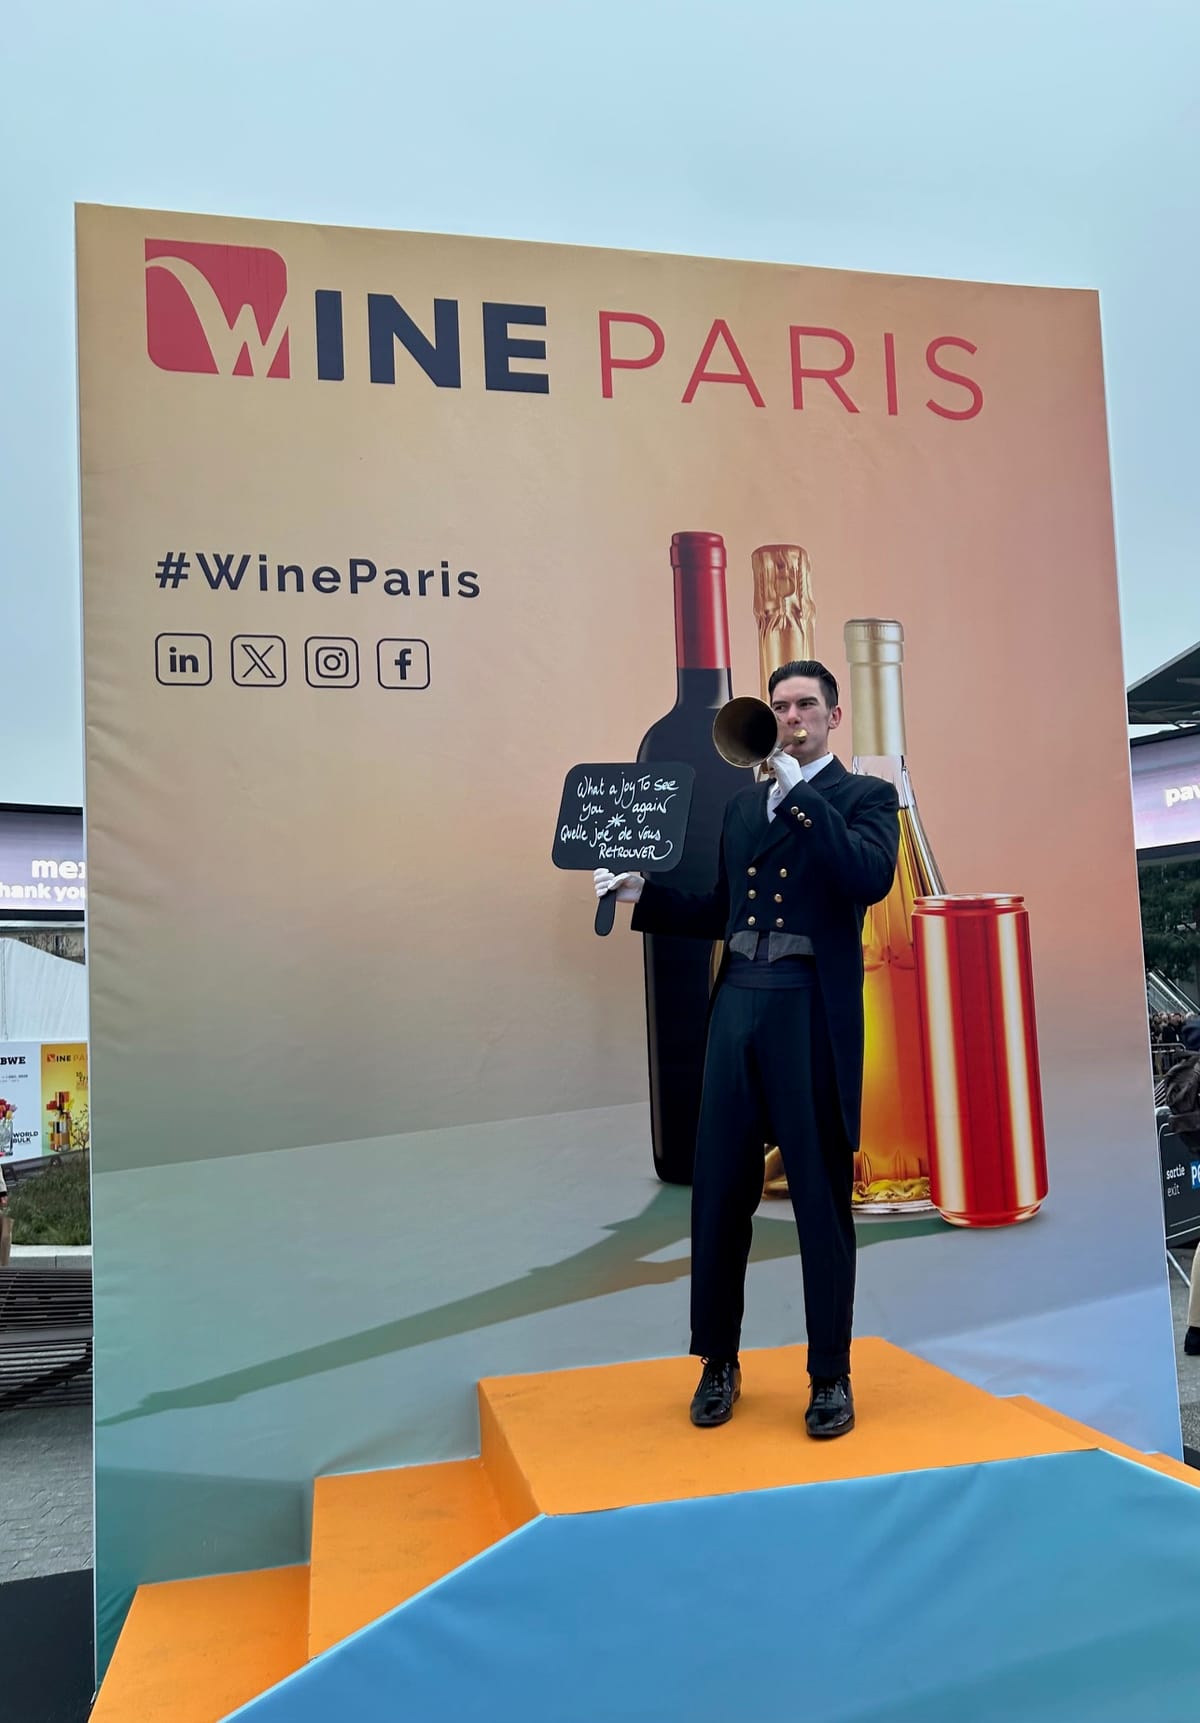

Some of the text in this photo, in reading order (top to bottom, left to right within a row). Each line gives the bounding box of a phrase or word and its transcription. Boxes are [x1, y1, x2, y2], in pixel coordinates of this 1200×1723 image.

[599, 310, 984, 421] PARIS
[155, 552, 481, 598] #WineParis
[169, 647, 199, 673] in
[394, 648, 412, 680] f
[577, 776, 605, 798] What
[609, 784, 618, 795] a
[615, 772, 636, 809] joy
[653, 778, 679, 791] see
[579, 802, 604, 821] you
[560, 824, 588, 843] Quelle
[618, 826, 632, 841] de
[638, 825, 661, 842] vous
[0, 882, 52, 899] hank
[1166, 1164, 1185, 1180] sortie
[1167, 1183, 1180, 1197] exit
